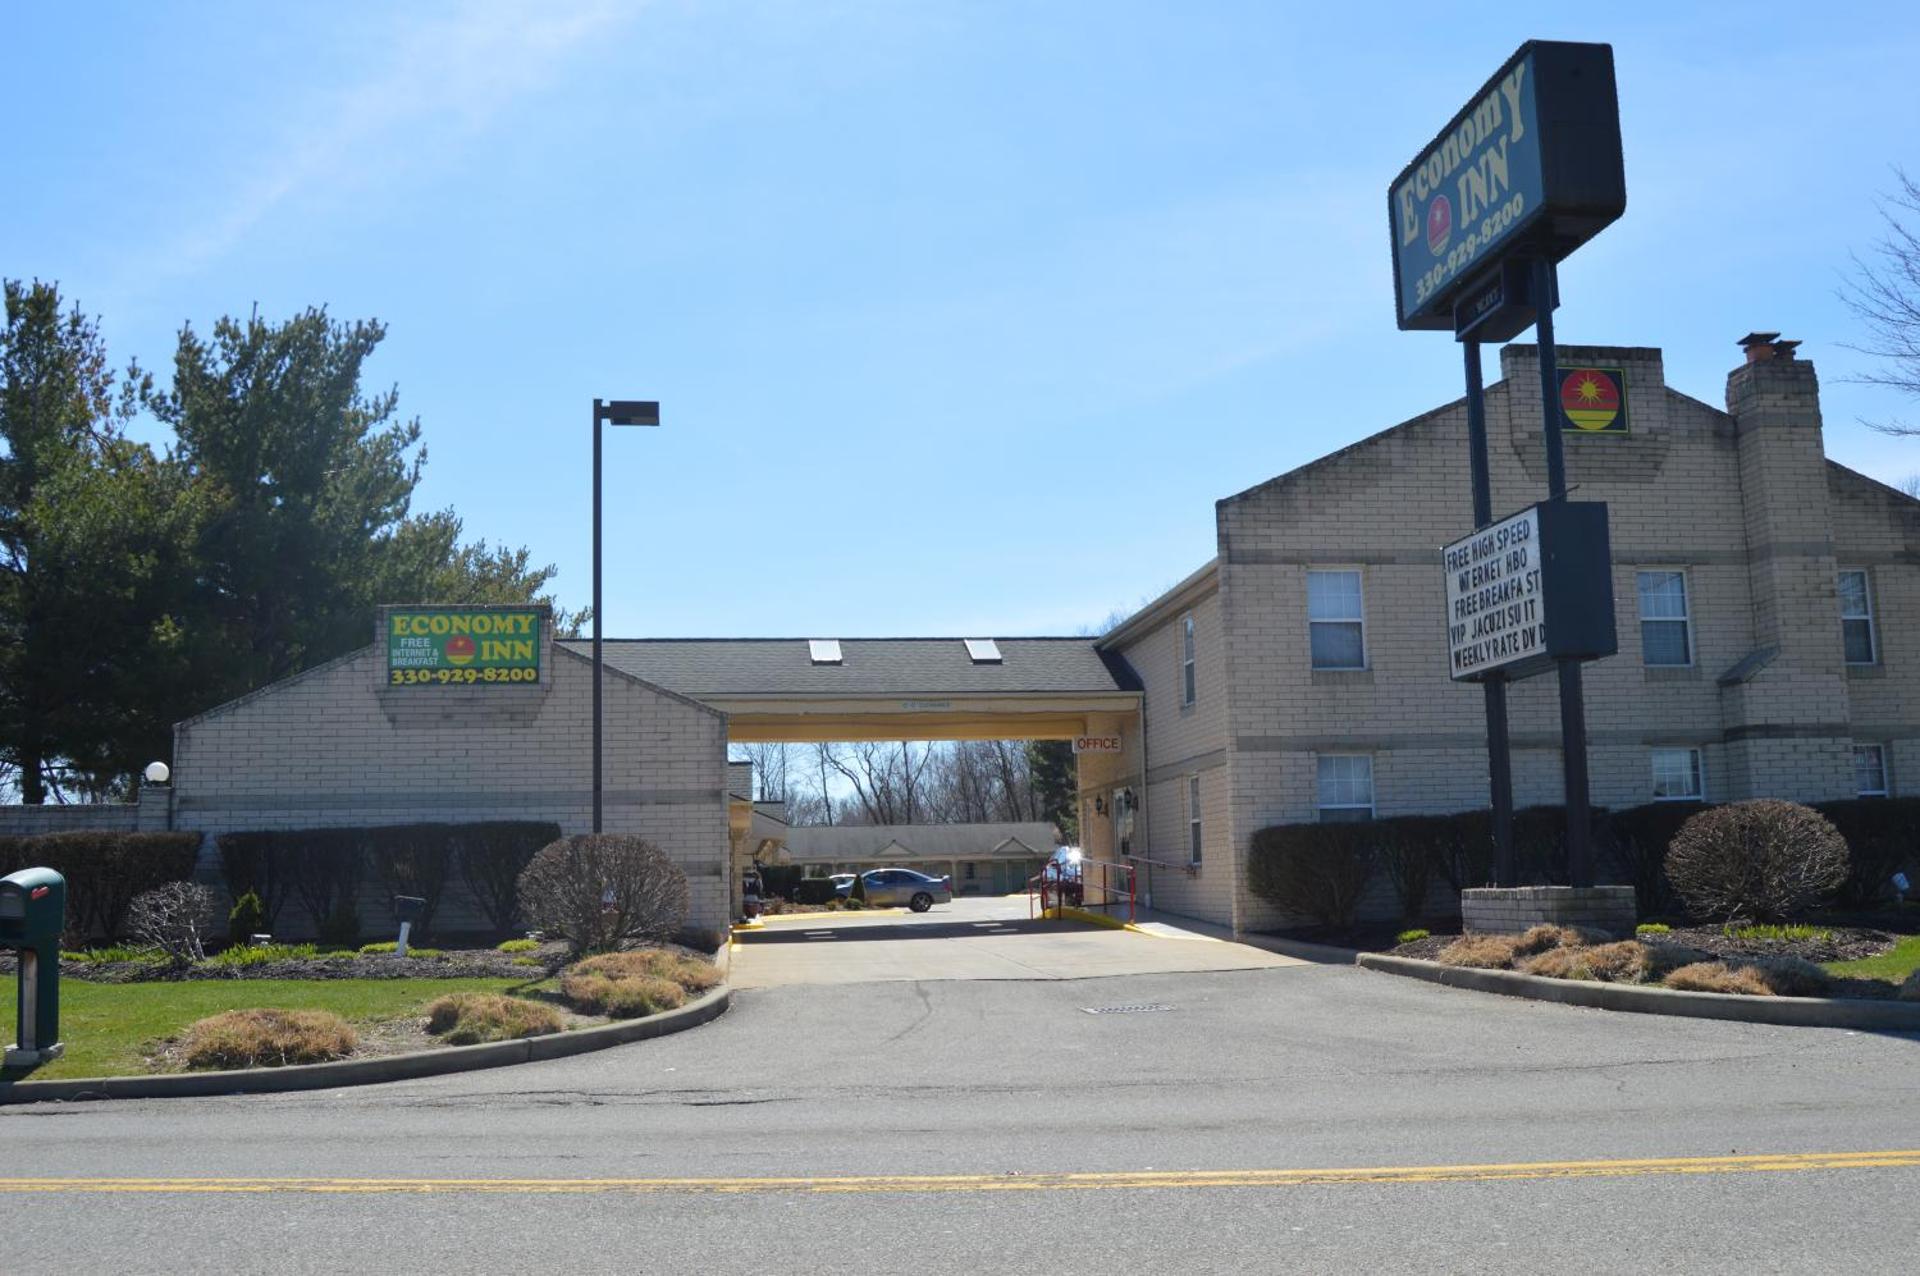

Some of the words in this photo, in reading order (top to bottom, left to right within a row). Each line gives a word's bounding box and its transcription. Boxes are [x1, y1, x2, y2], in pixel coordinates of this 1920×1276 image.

[1457, 134, 1509, 230] INN
[1416, 192, 1524, 304] 330-929-8200
[1447, 545, 1469, 572] FREE
[1471, 533, 1494, 561] HIGH
[1497, 519, 1530, 550] SPEED
[1506, 547, 1528, 574] HBO
[1454, 596, 1478, 620] FREE
[392, 614, 536, 635] ECONOMY
[1451, 623, 1467, 645] VIP
[1471, 609, 1506, 638] JACUZI
[400, 638, 432, 648] FREE
[481, 640, 534, 661] INN
[392, 658, 439, 666] BREAKFAST
[391, 667, 537, 685] 330-929-8200
[1077, 737, 1119, 750] OFFICE
